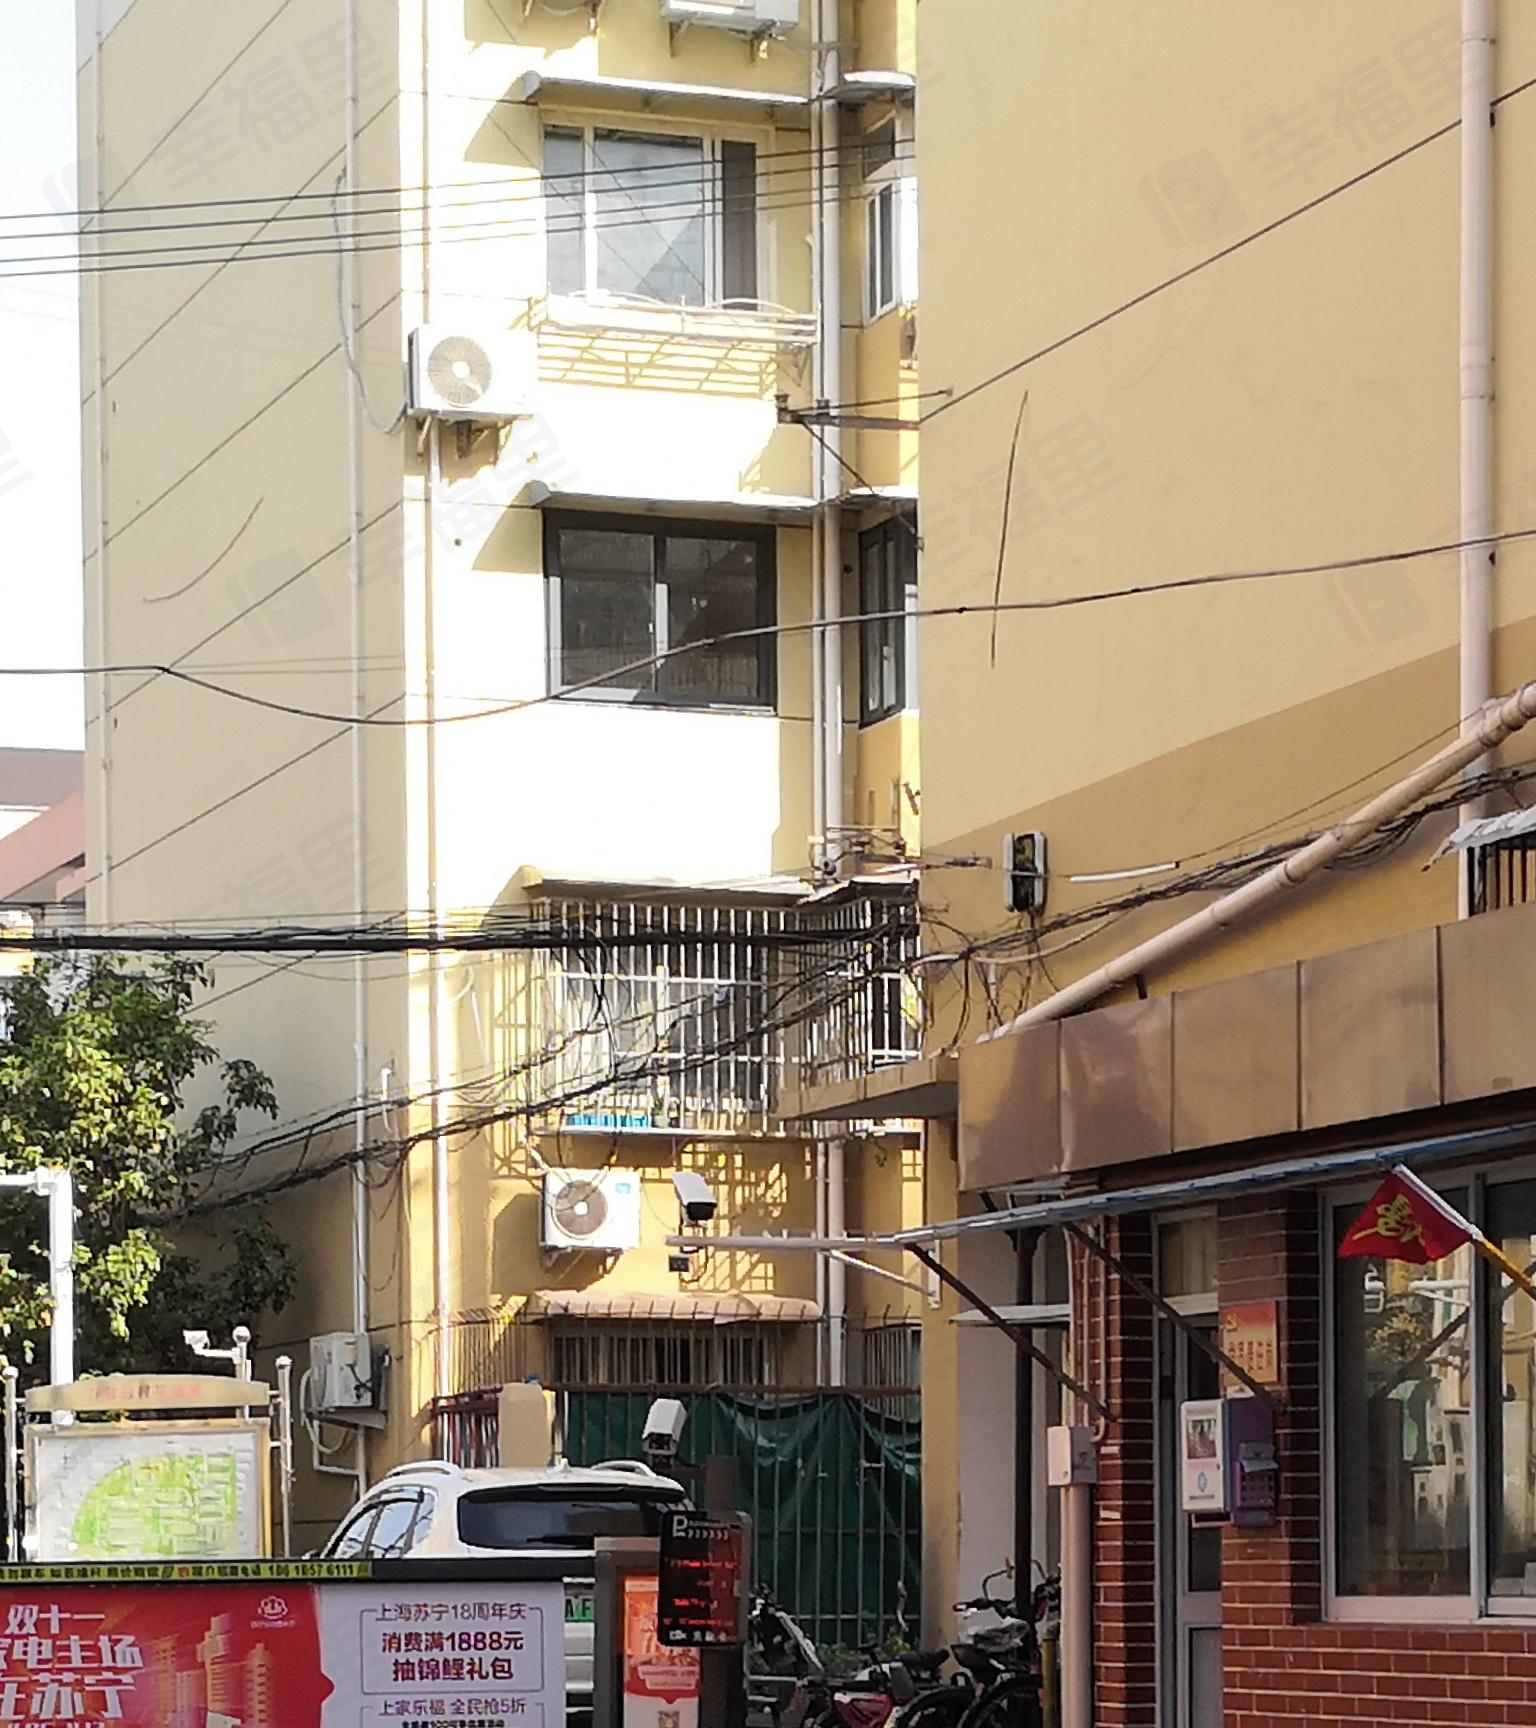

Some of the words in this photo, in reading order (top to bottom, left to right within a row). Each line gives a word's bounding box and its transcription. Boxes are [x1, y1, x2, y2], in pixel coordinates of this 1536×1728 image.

[4, 1604, 106, 1634] 双十一
[375, 1602, 527, 1622] 上海苏宁18周年庆
[381, 1630, 524, 1653] 消费满1888元
[392, 1656, 515, 1682] 抽锦鲤礼包
